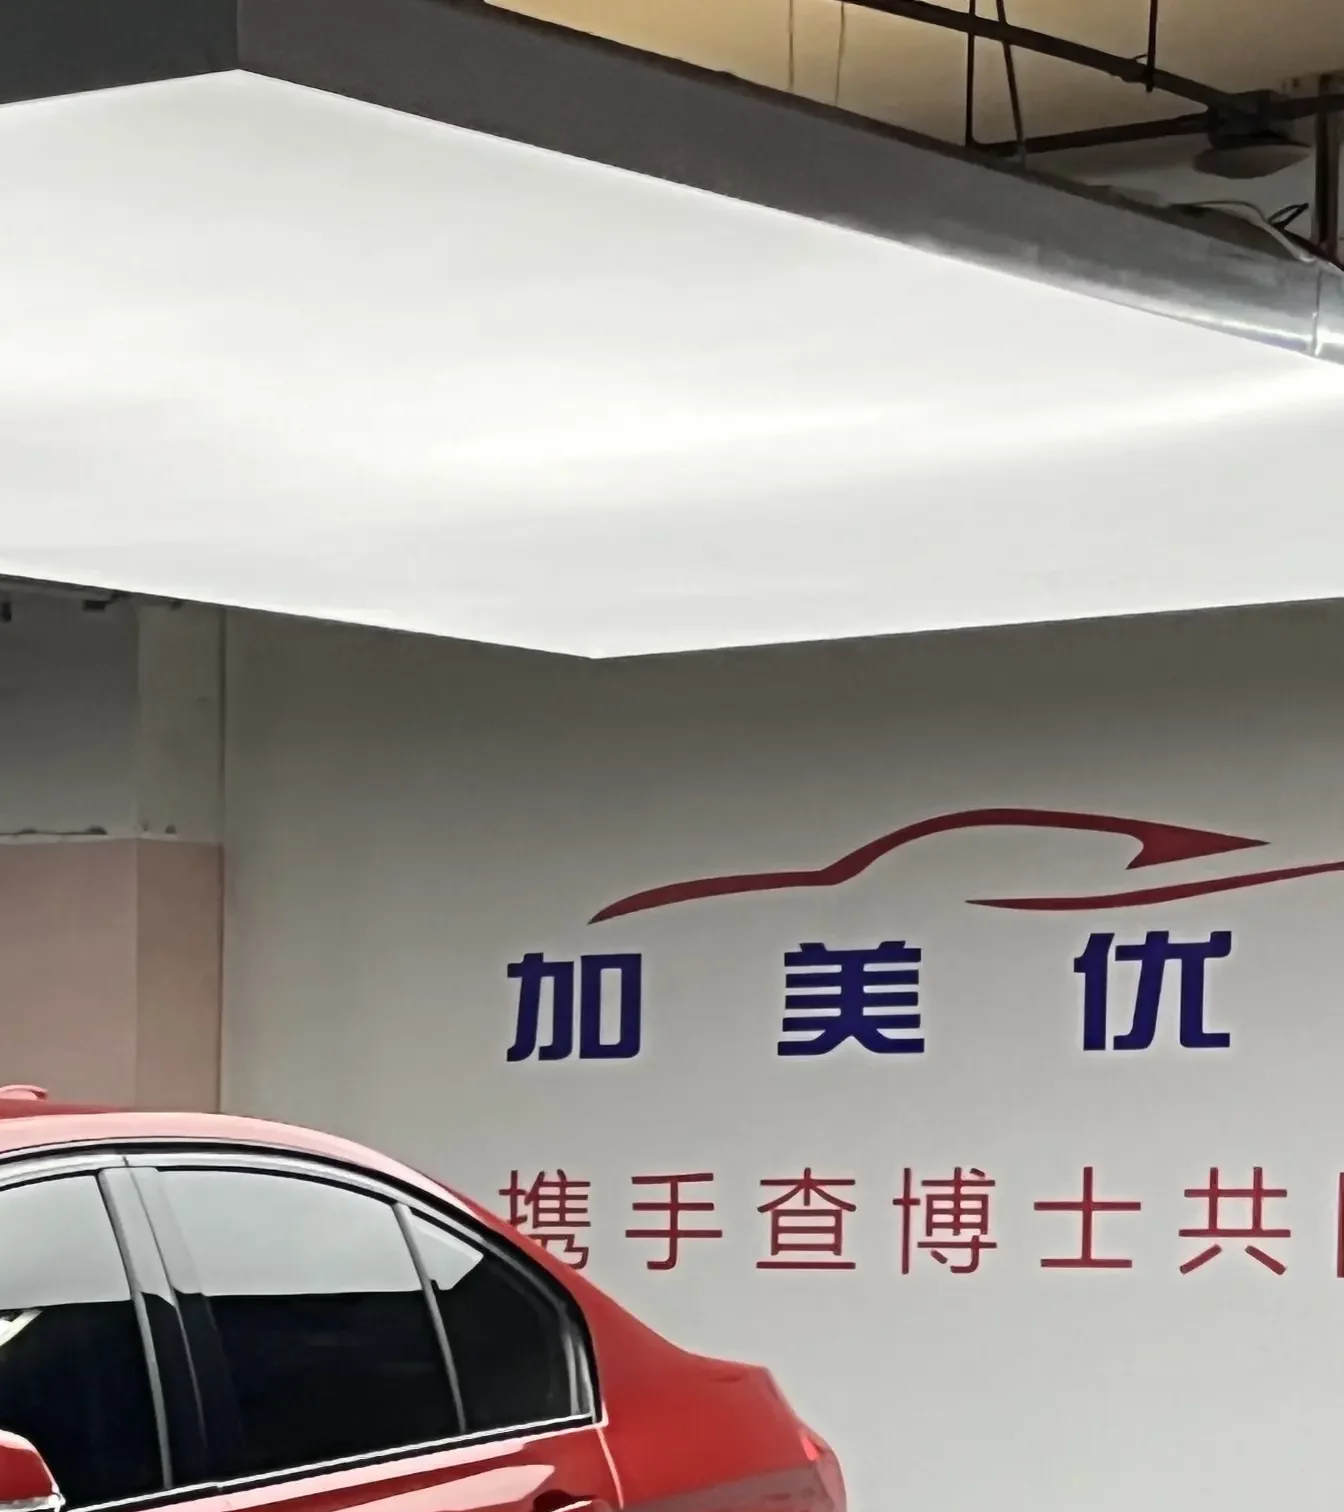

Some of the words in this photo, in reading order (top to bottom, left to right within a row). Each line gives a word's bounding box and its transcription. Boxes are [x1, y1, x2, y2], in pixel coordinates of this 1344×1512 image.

[506, 930, 1234, 1063] 加美优
[498, 1165, 1344, 1278] 携手查博士共
